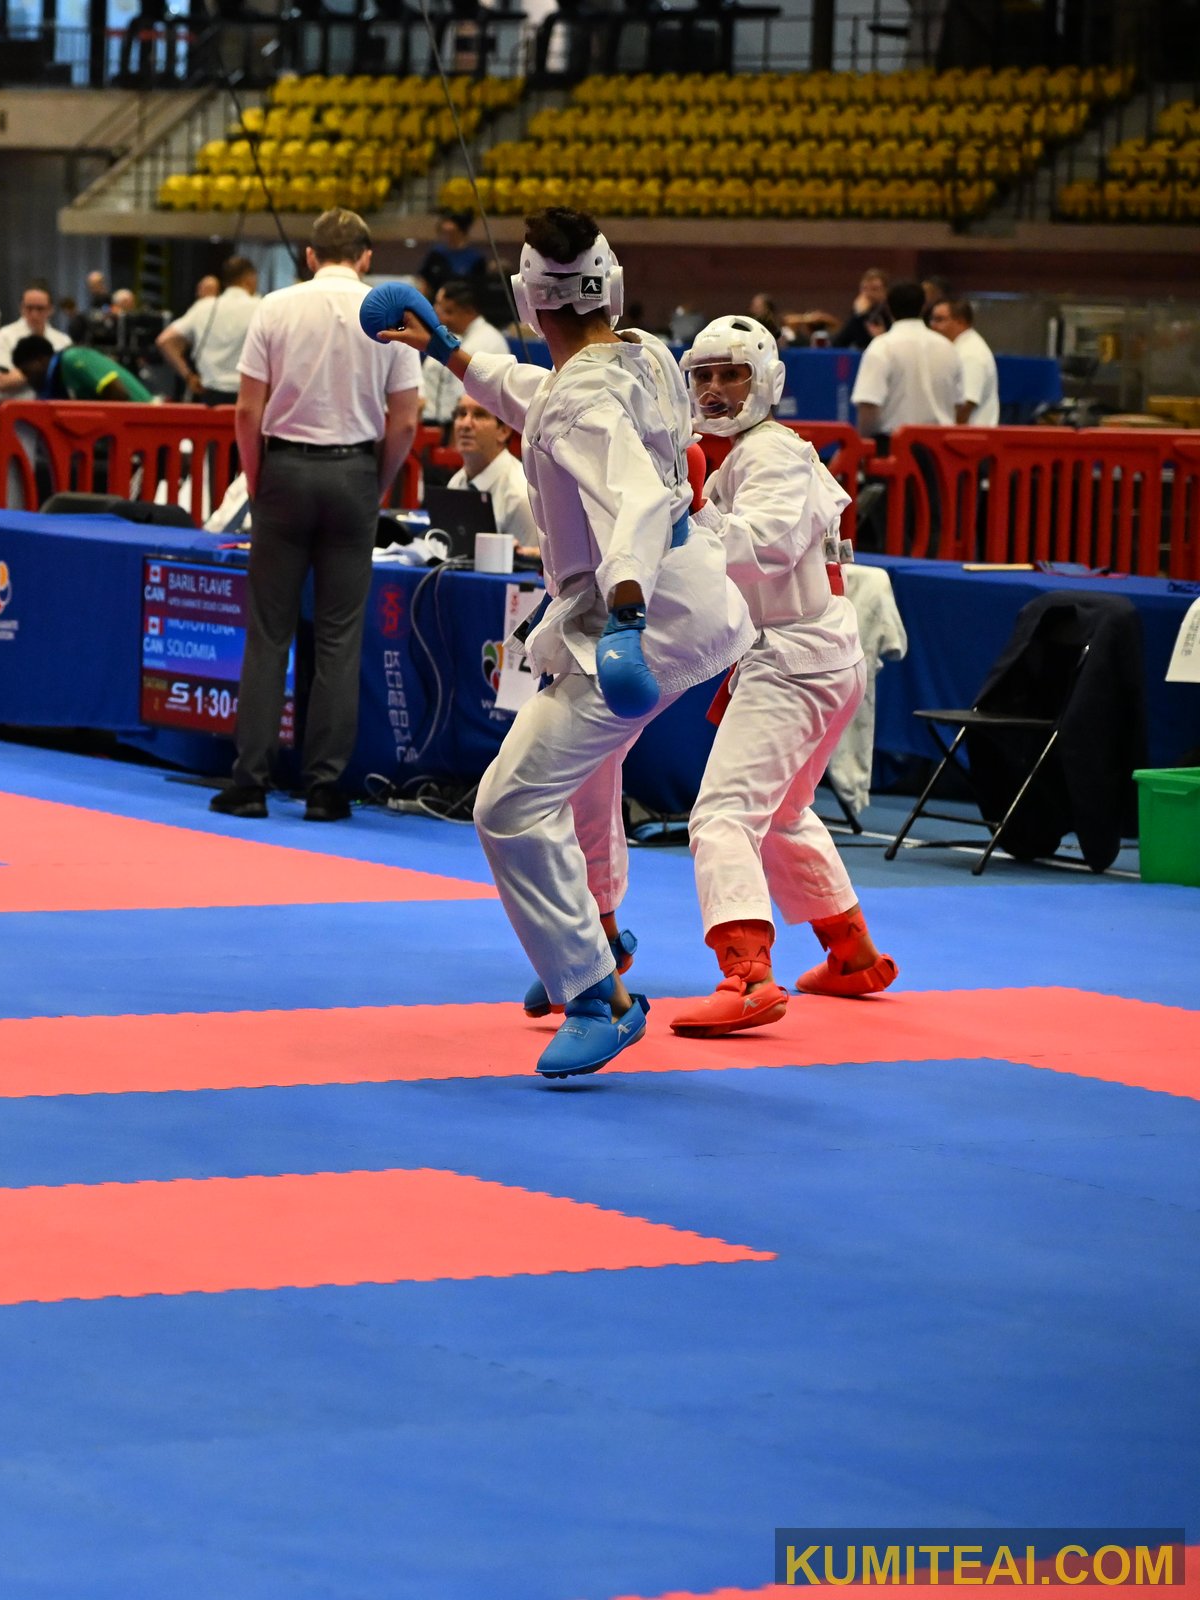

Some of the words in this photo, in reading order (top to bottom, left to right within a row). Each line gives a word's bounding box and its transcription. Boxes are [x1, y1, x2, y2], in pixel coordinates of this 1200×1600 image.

[144, 585, 165, 601] CAN
[168, 572, 196, 593] BARIL
[199, 575, 233, 597] FLAVIE
[143, 636, 164, 655] CAN
